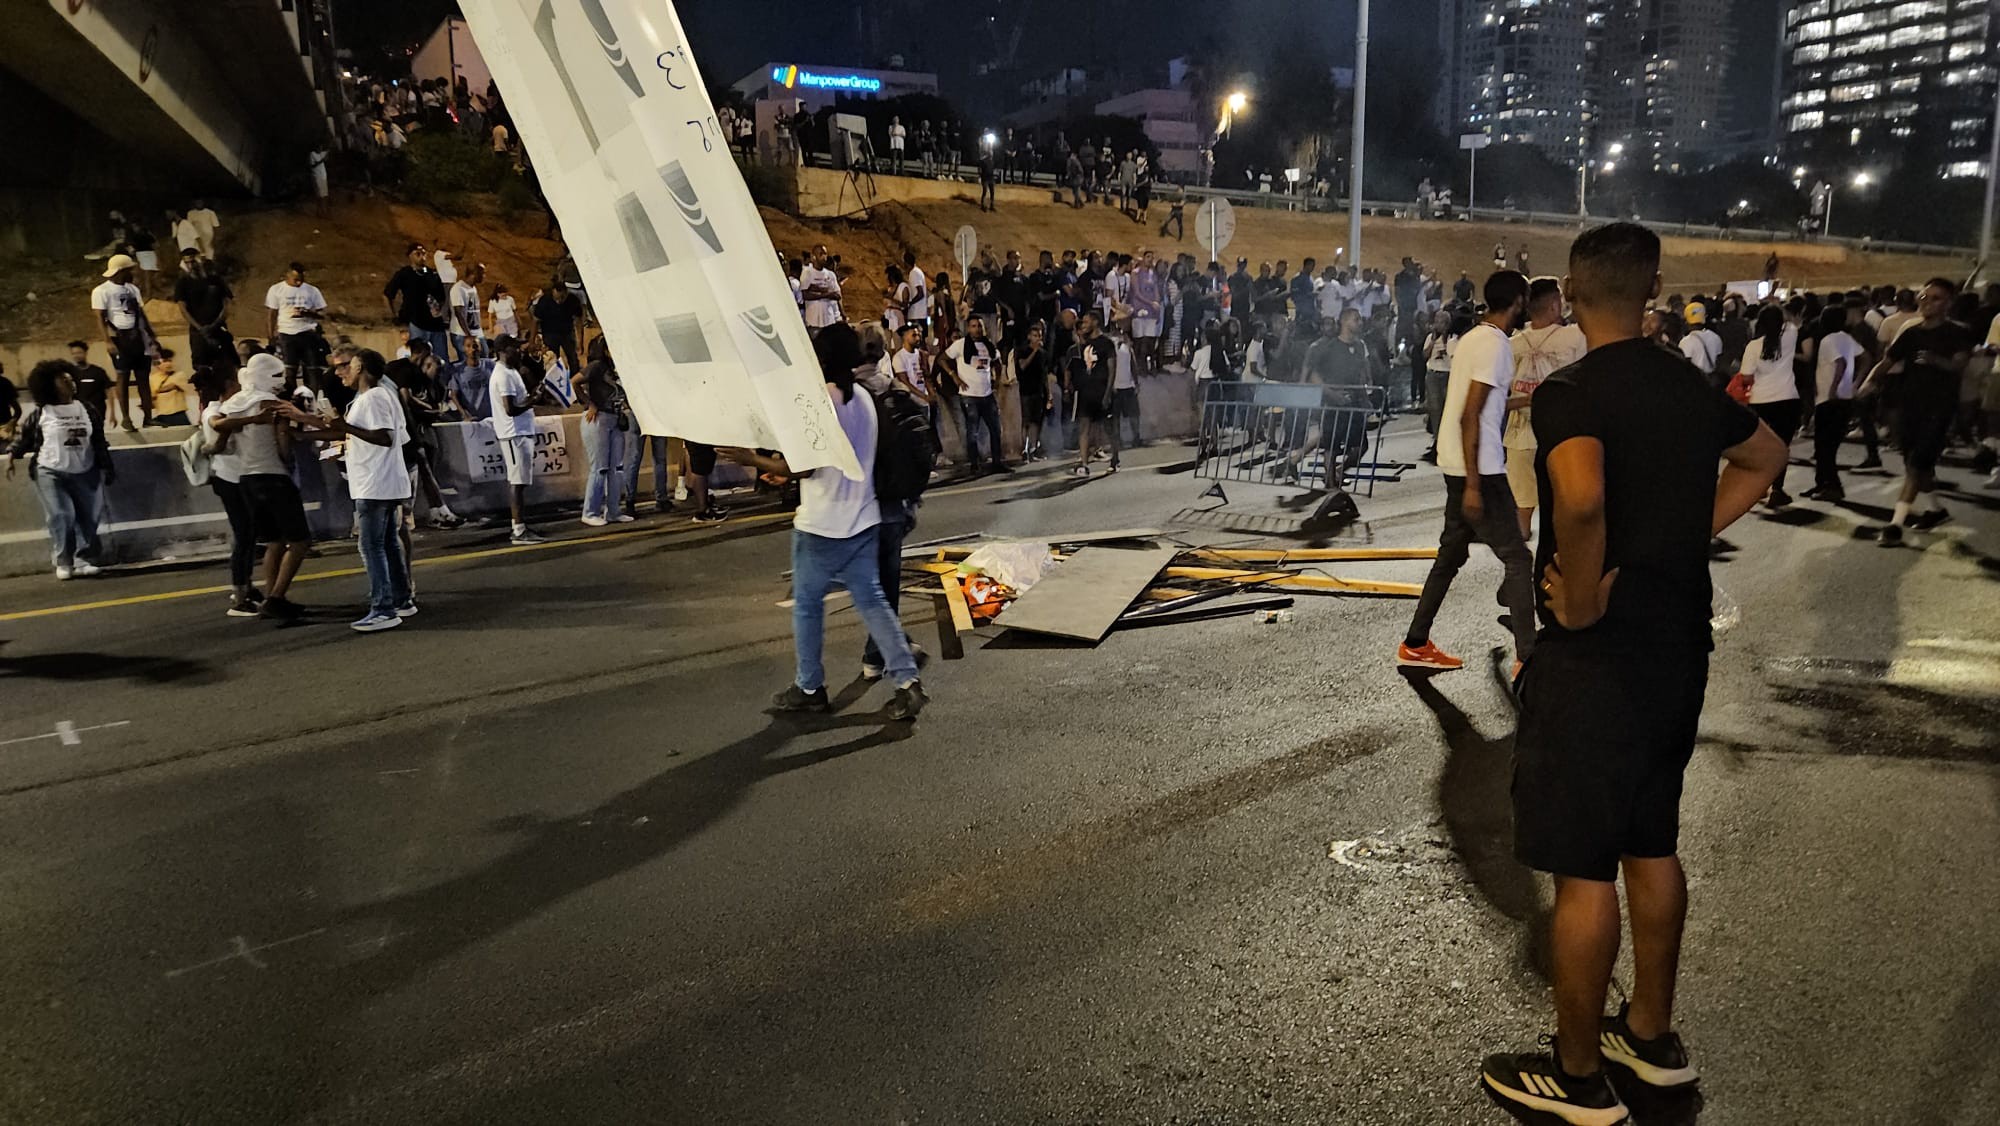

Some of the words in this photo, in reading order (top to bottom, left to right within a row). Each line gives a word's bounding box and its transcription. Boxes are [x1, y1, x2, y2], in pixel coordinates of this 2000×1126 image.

[800, 72, 880, 91] ManpowerGroup
[478, 454, 503, 464] כבר
[543, 458, 563, 472] לא
